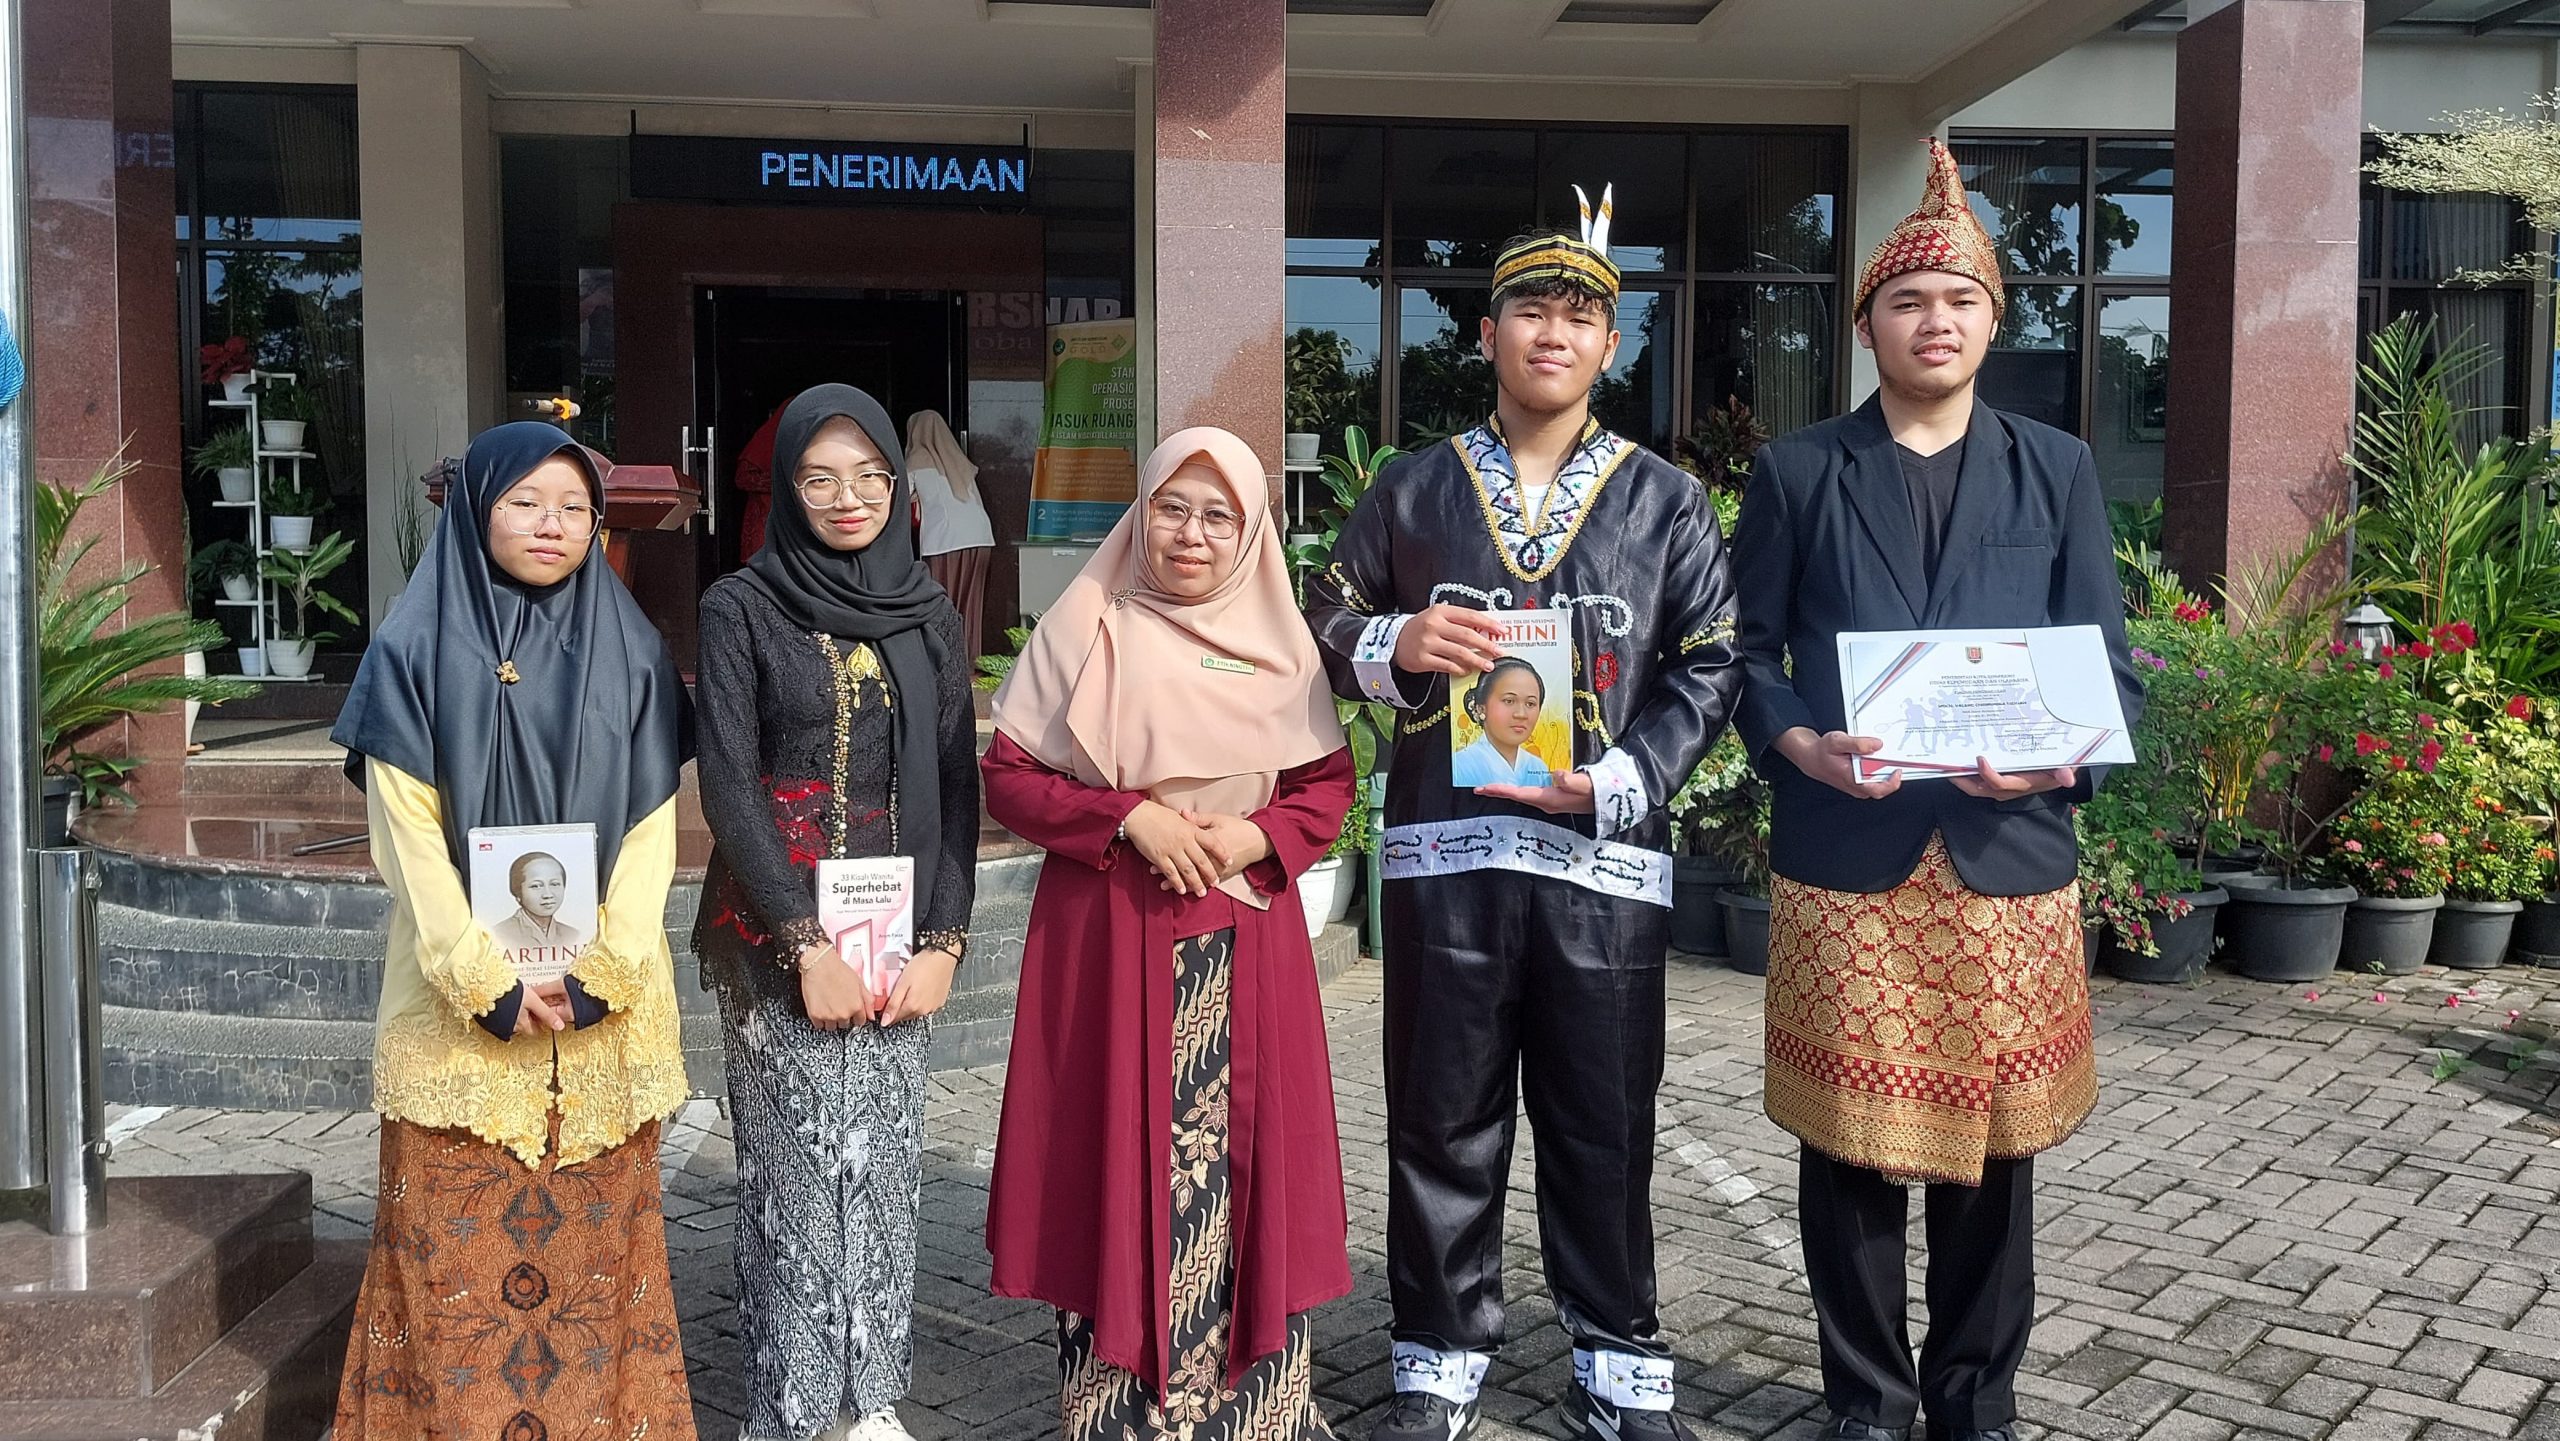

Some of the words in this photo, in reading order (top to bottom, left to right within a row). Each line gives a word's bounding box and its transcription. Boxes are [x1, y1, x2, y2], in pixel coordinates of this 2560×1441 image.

[761, 152, 1025, 192] PENERIMAAN
[1091, 413, 1136, 428] RUANG
[1037, 508, 1046, 520] 2
[851, 873, 869, 881] Kisah
[832, 881, 902, 896] Superhebat
[842, 897, 850, 905] di
[875, 895, 892, 904] Lalu
